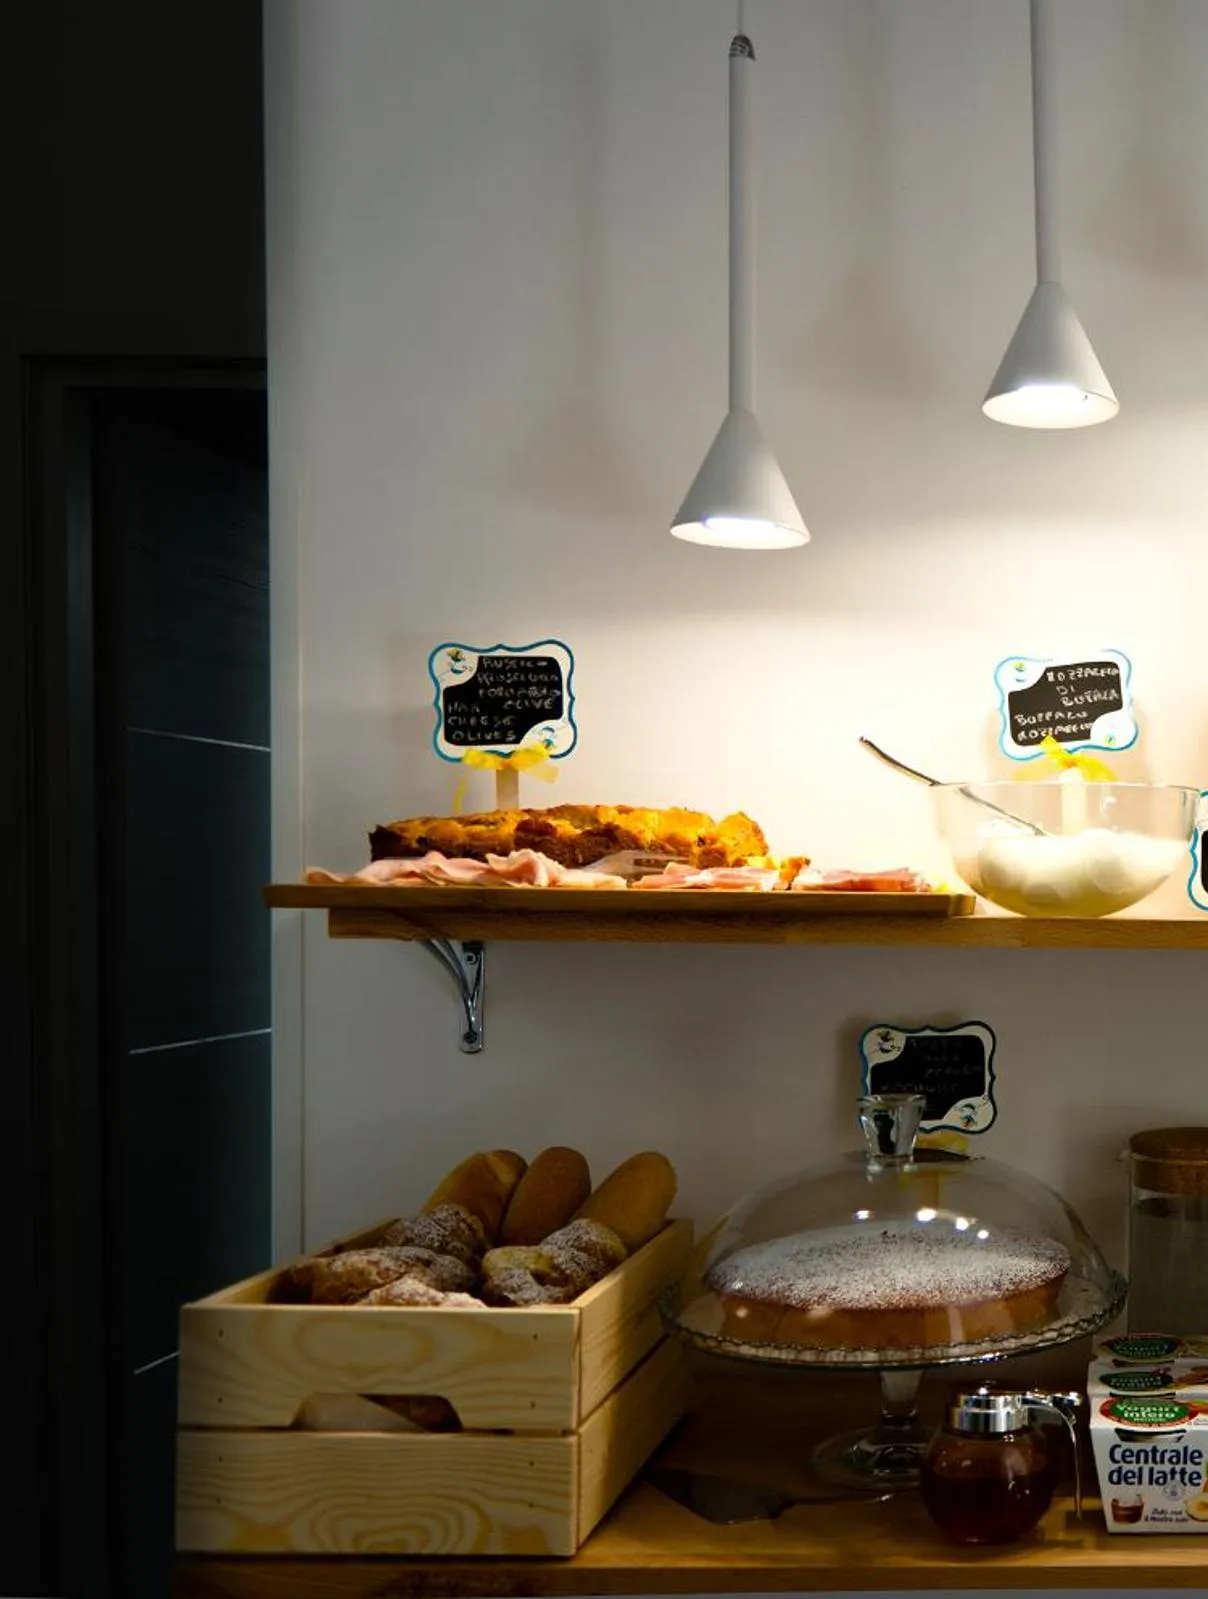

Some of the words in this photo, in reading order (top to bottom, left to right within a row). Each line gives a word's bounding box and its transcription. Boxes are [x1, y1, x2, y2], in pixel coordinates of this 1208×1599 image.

[452, 731, 516, 742] OLIVES
[1109, 1443, 1203, 1465] Centrale
[1108, 1465, 1143, 1485] del
[1148, 1466, 1202, 1487] latte
